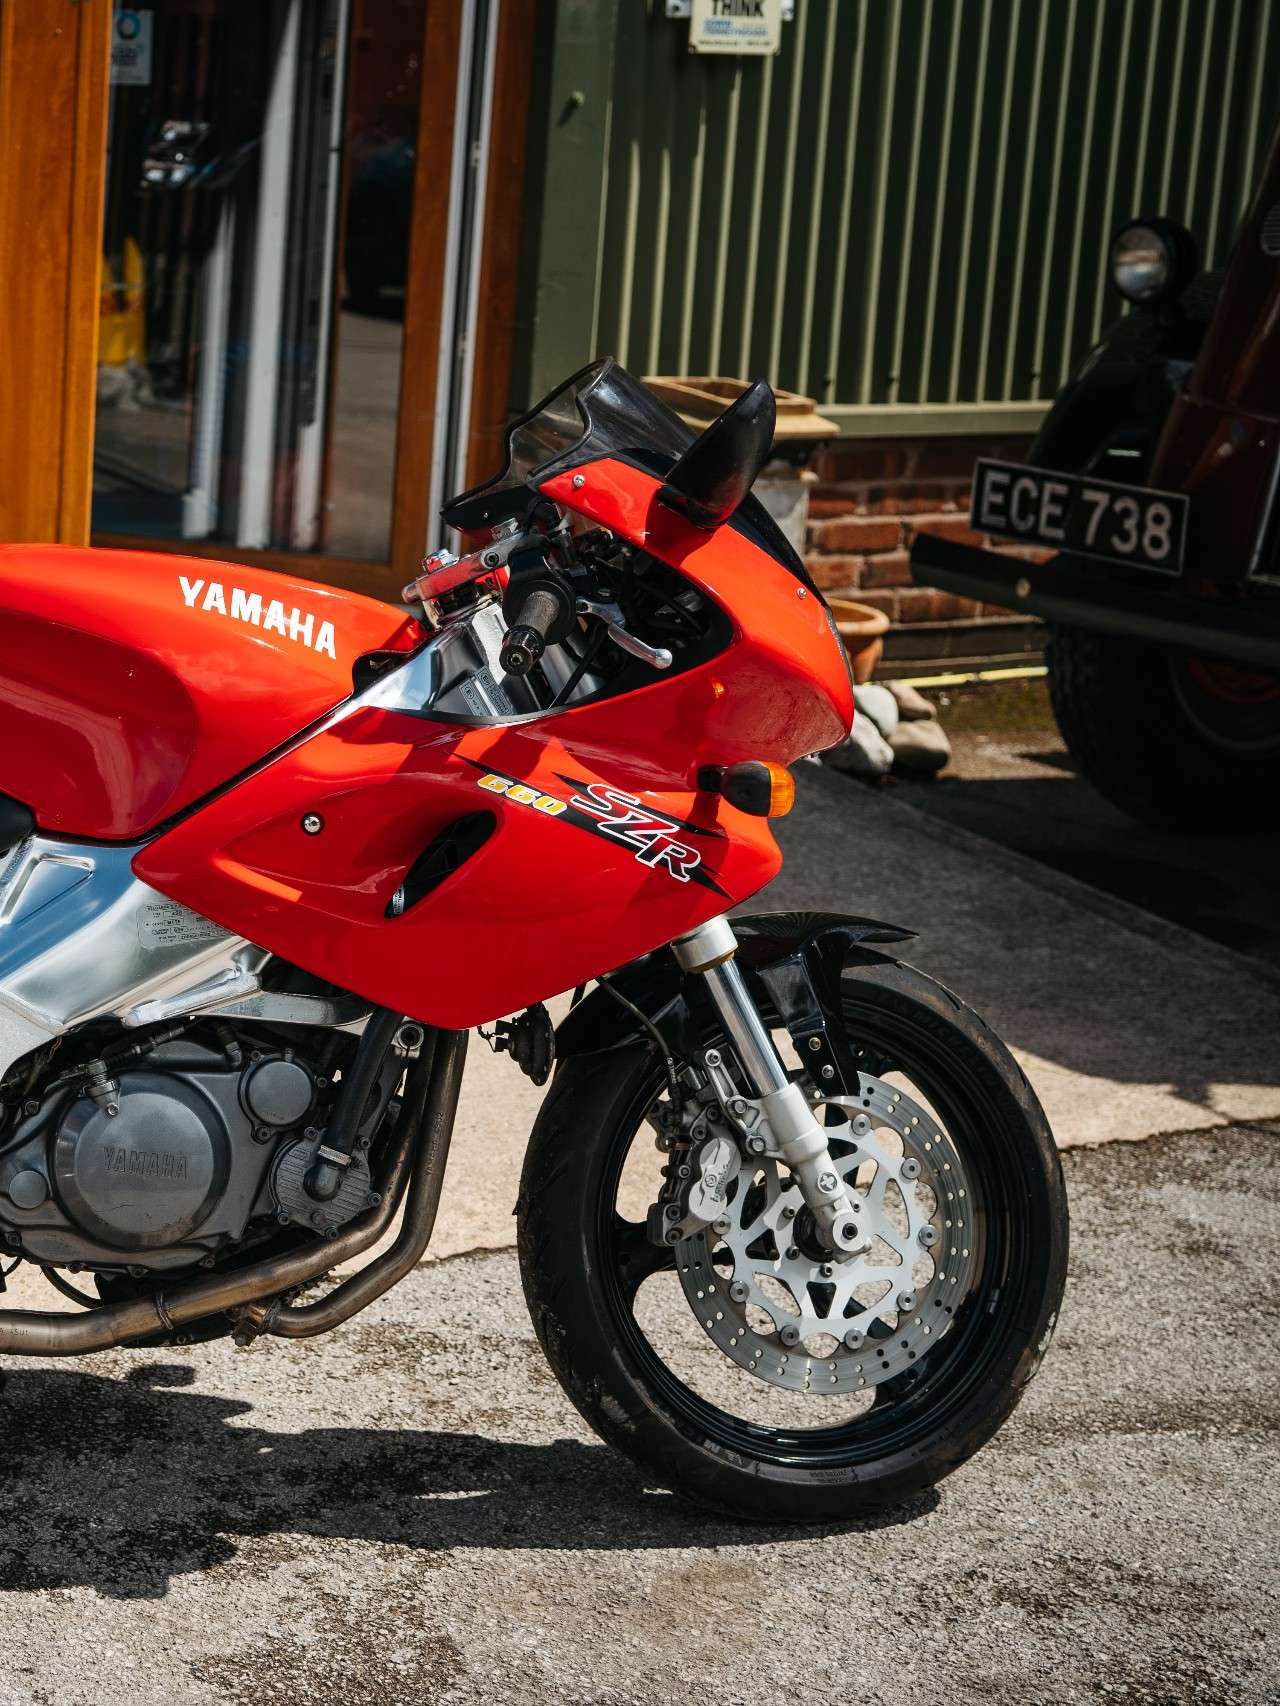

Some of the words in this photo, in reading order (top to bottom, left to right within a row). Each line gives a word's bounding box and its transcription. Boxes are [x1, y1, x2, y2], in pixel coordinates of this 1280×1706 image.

[979, 469, 1069, 539] ECE
[1081, 488, 1171, 560] 738
[178, 575, 338, 660] YAMAHA
[477, 773, 568, 816] 660
[570, 783, 702, 883] SZR
[103, 1146, 189, 1180] YAMAHA
